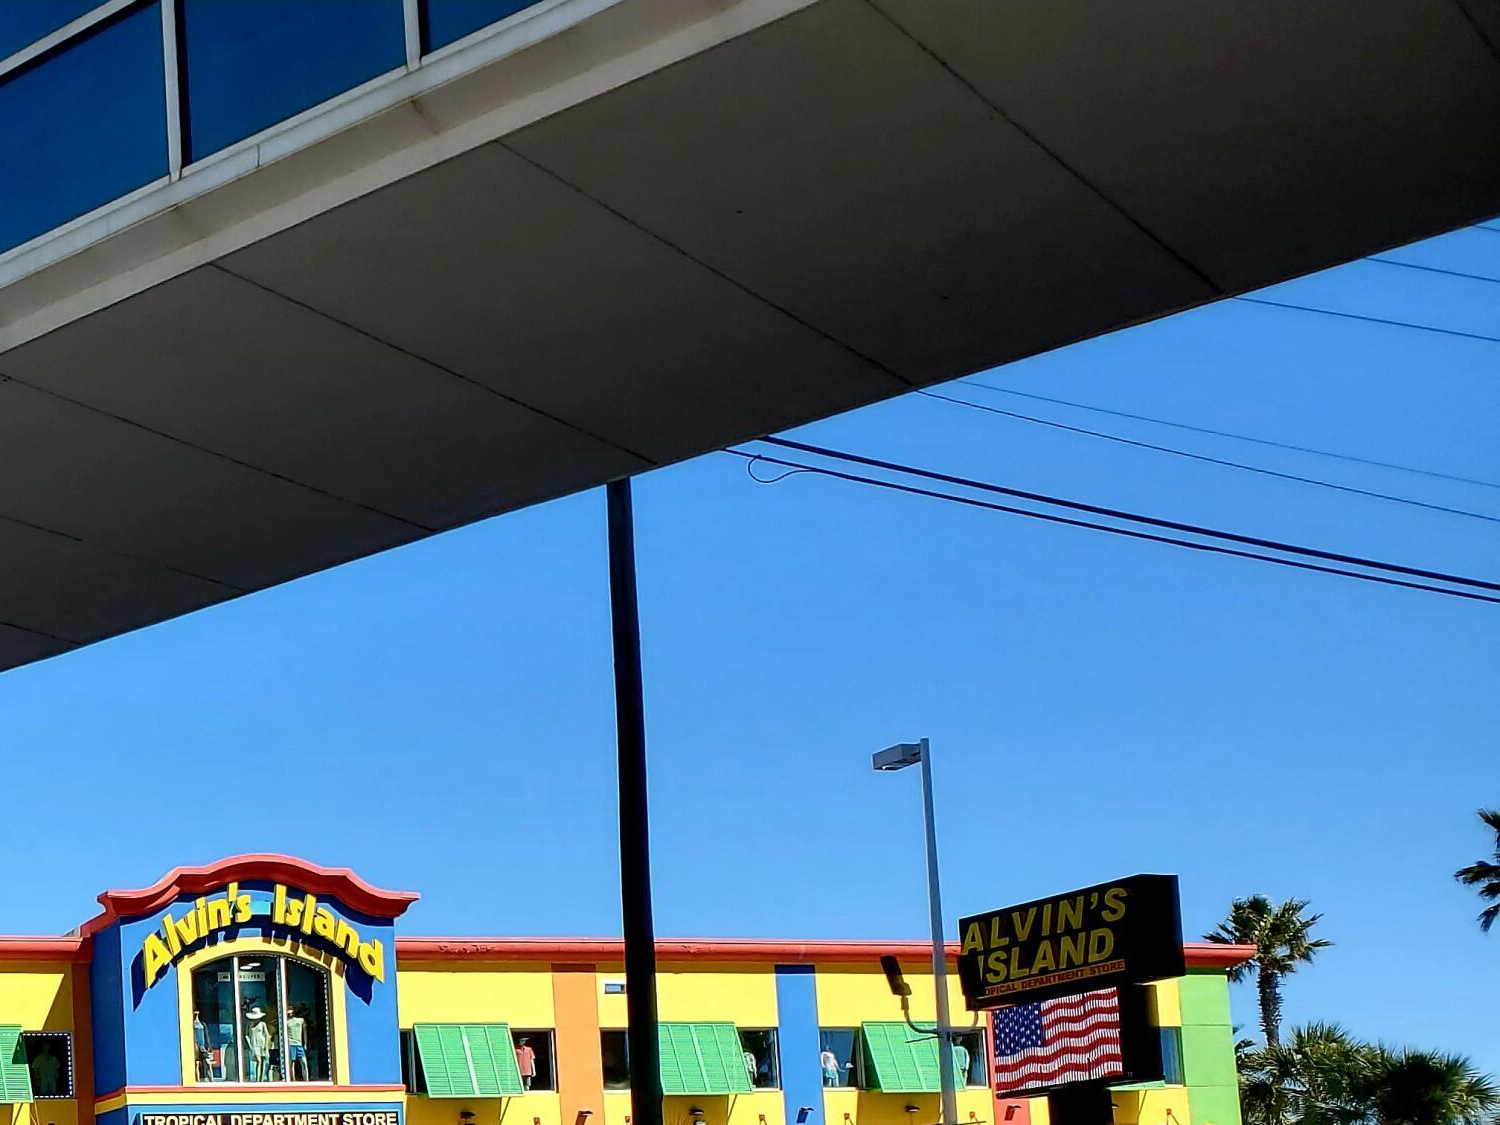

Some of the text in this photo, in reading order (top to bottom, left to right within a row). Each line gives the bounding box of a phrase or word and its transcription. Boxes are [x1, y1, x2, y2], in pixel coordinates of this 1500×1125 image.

[143, 882, 385, 989] Alvin's Island
[962, 888, 1128, 956] ALVIN'S
[1021, 968, 1085, 990] DEPARTMENT
[1089, 961, 1125, 975] STORE
